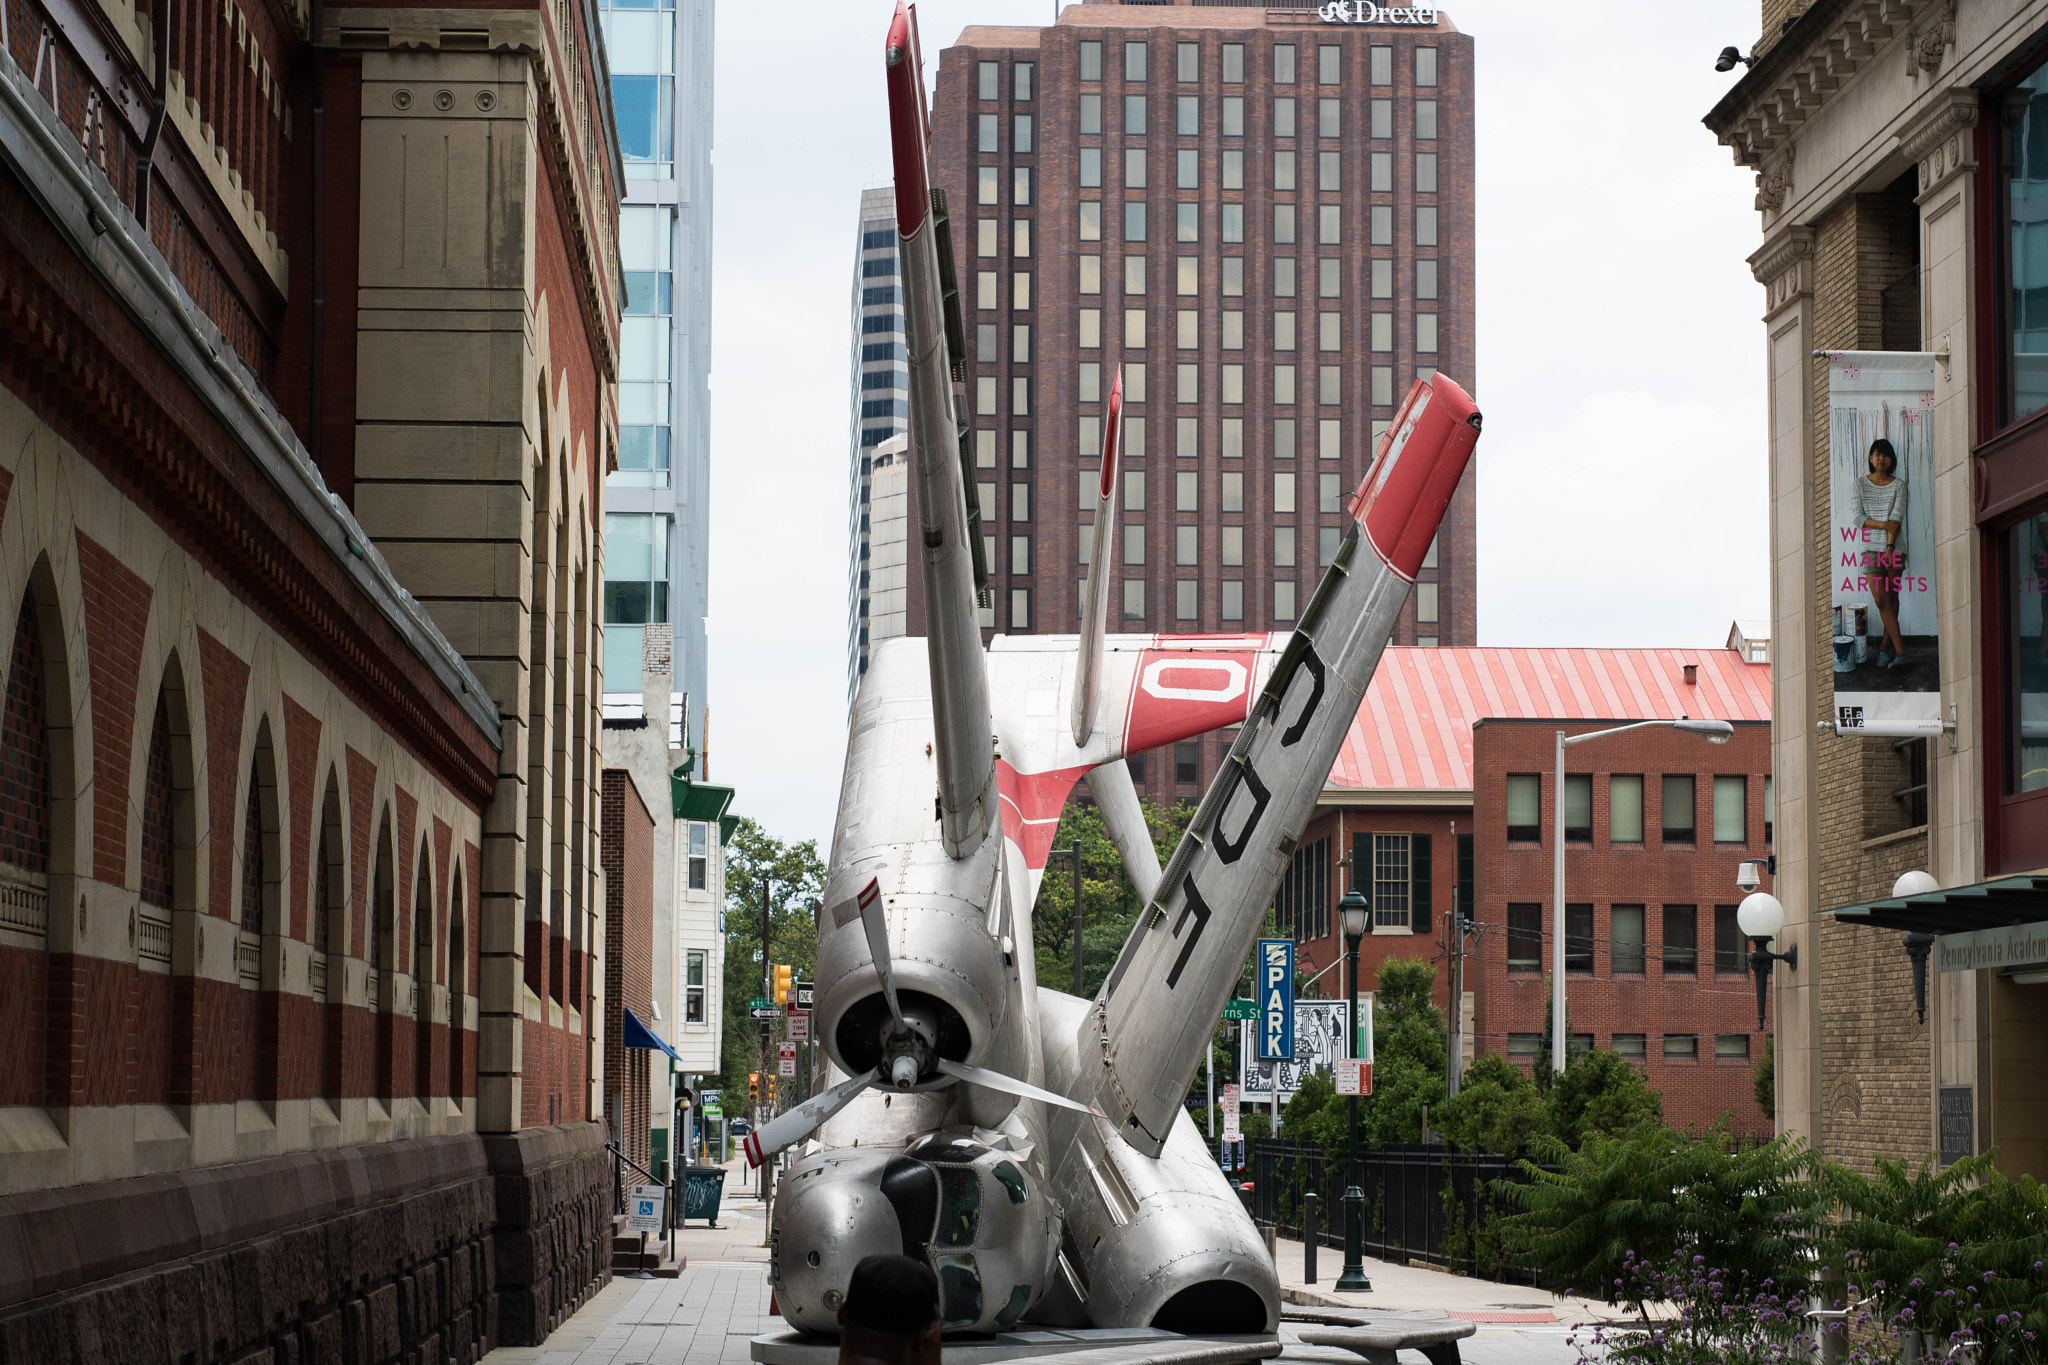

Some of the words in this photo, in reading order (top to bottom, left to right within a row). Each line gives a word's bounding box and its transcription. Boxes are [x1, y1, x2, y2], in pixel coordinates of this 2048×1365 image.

[1353, 0, 1440, 25] Drexel
[1840, 527, 1872, 543] WE
[1840, 551, 1904, 568] MAKE
[1840, 576, 1929, 593] ARTISTS
[1940, 936, 2003, 970] Pennsylvania
[800, 991, 810, 1002] ONE
[1221, 1009, 1243, 1019] rns
[1248, 1007, 1262, 1019] St
[1267, 966, 1285, 1057] PARK
[1942, 1116, 1970, 1134] HAMILTON
[1943, 1136, 1970, 1154] BUILDING
